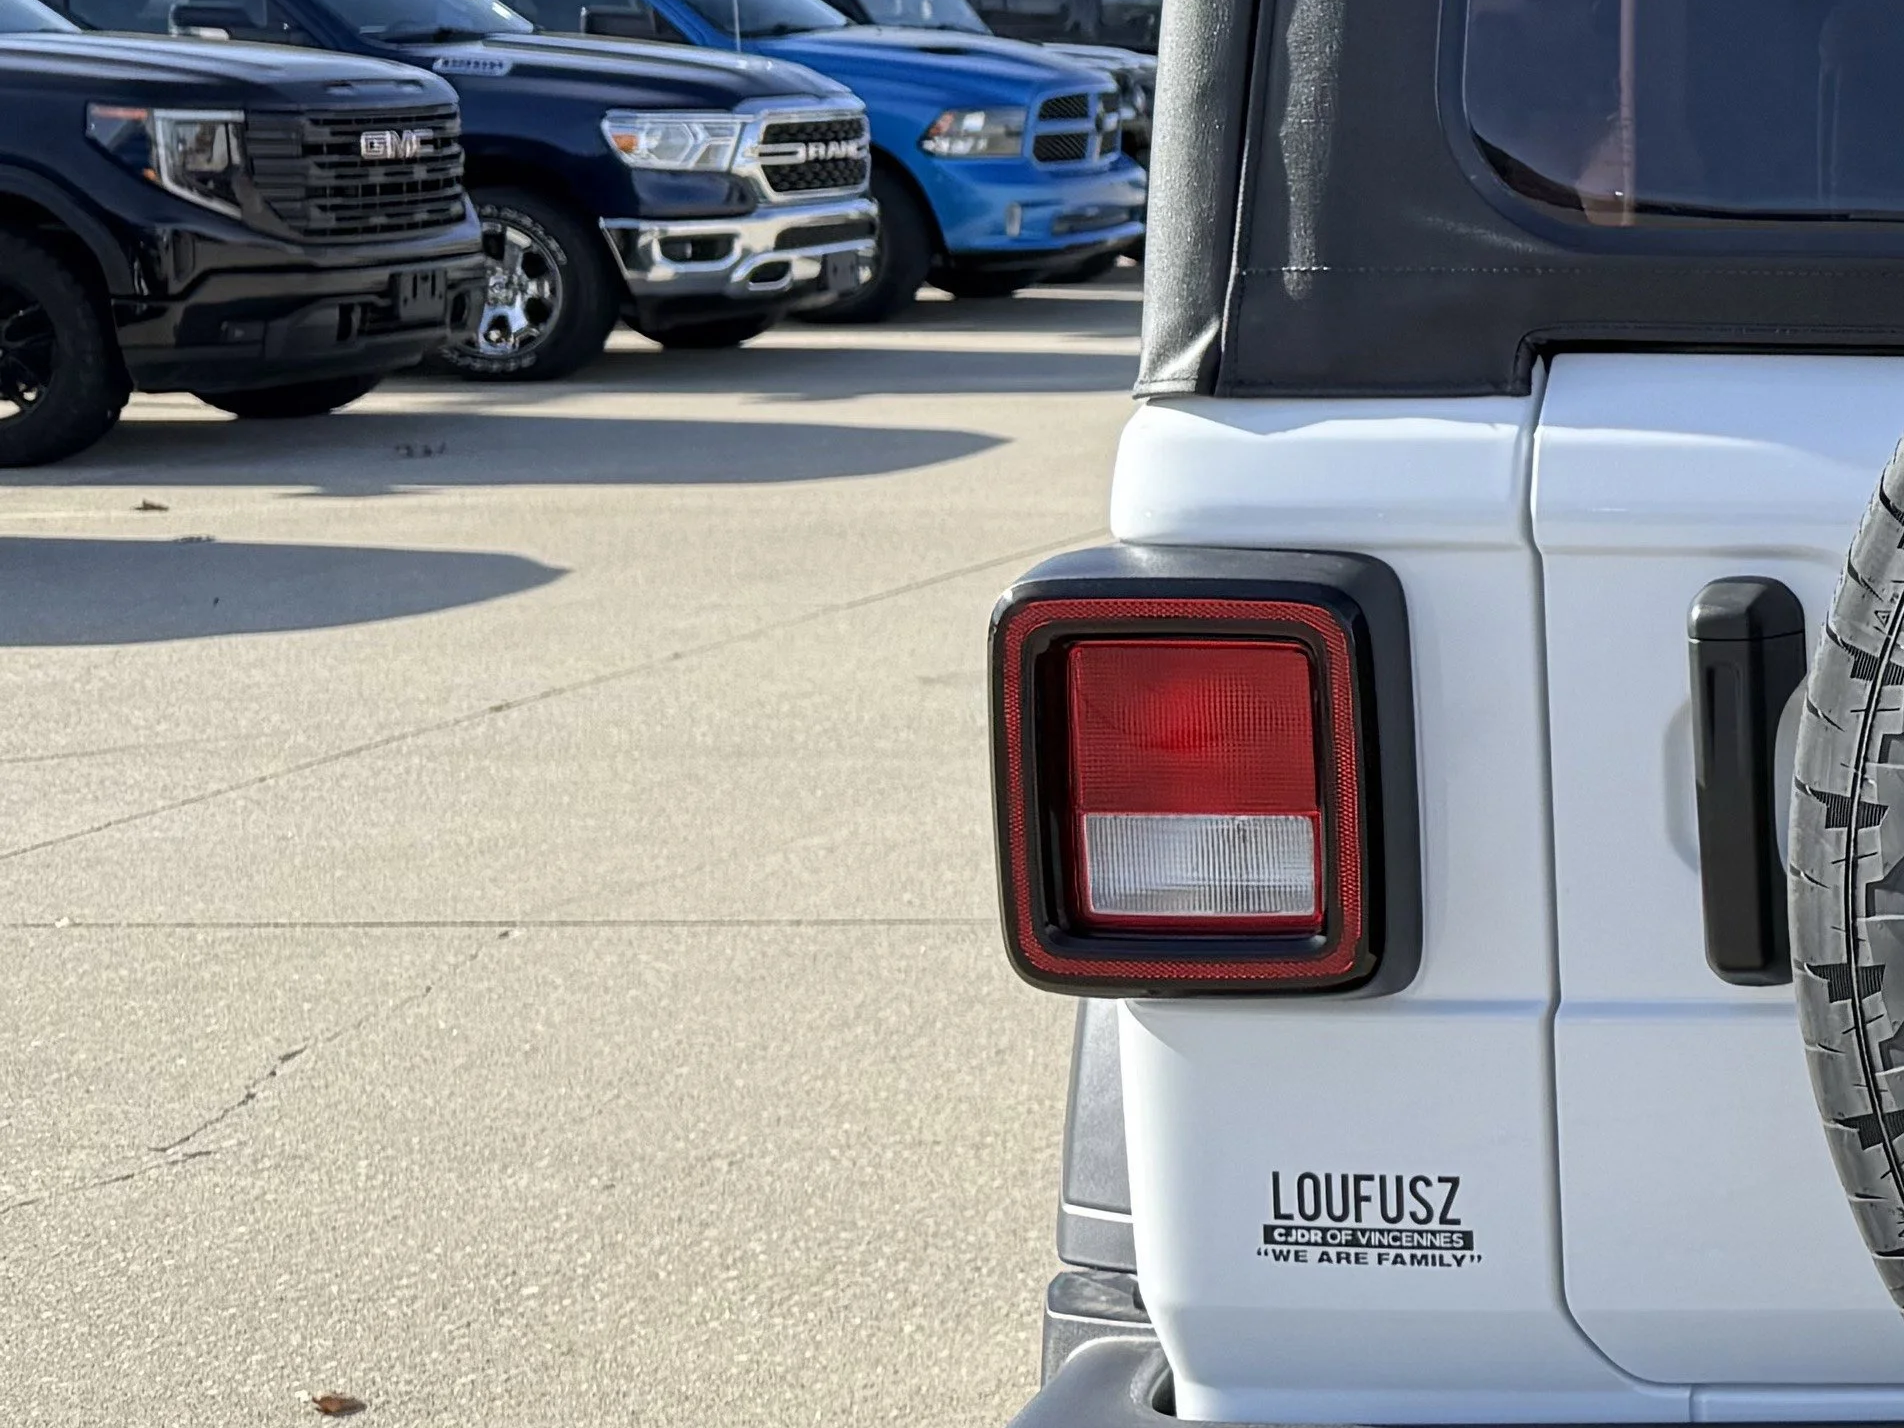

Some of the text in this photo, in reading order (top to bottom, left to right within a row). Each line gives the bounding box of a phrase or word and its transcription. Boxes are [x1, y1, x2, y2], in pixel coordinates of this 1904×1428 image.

[361, 129, 432, 160] GMC
[1271, 1170, 1462, 1226] LOUFUSZ
[1272, 1227, 1464, 1249] CJDR OF VINCENNES
[1256, 1247, 1483, 1268] “WE ARE FAMILY”
